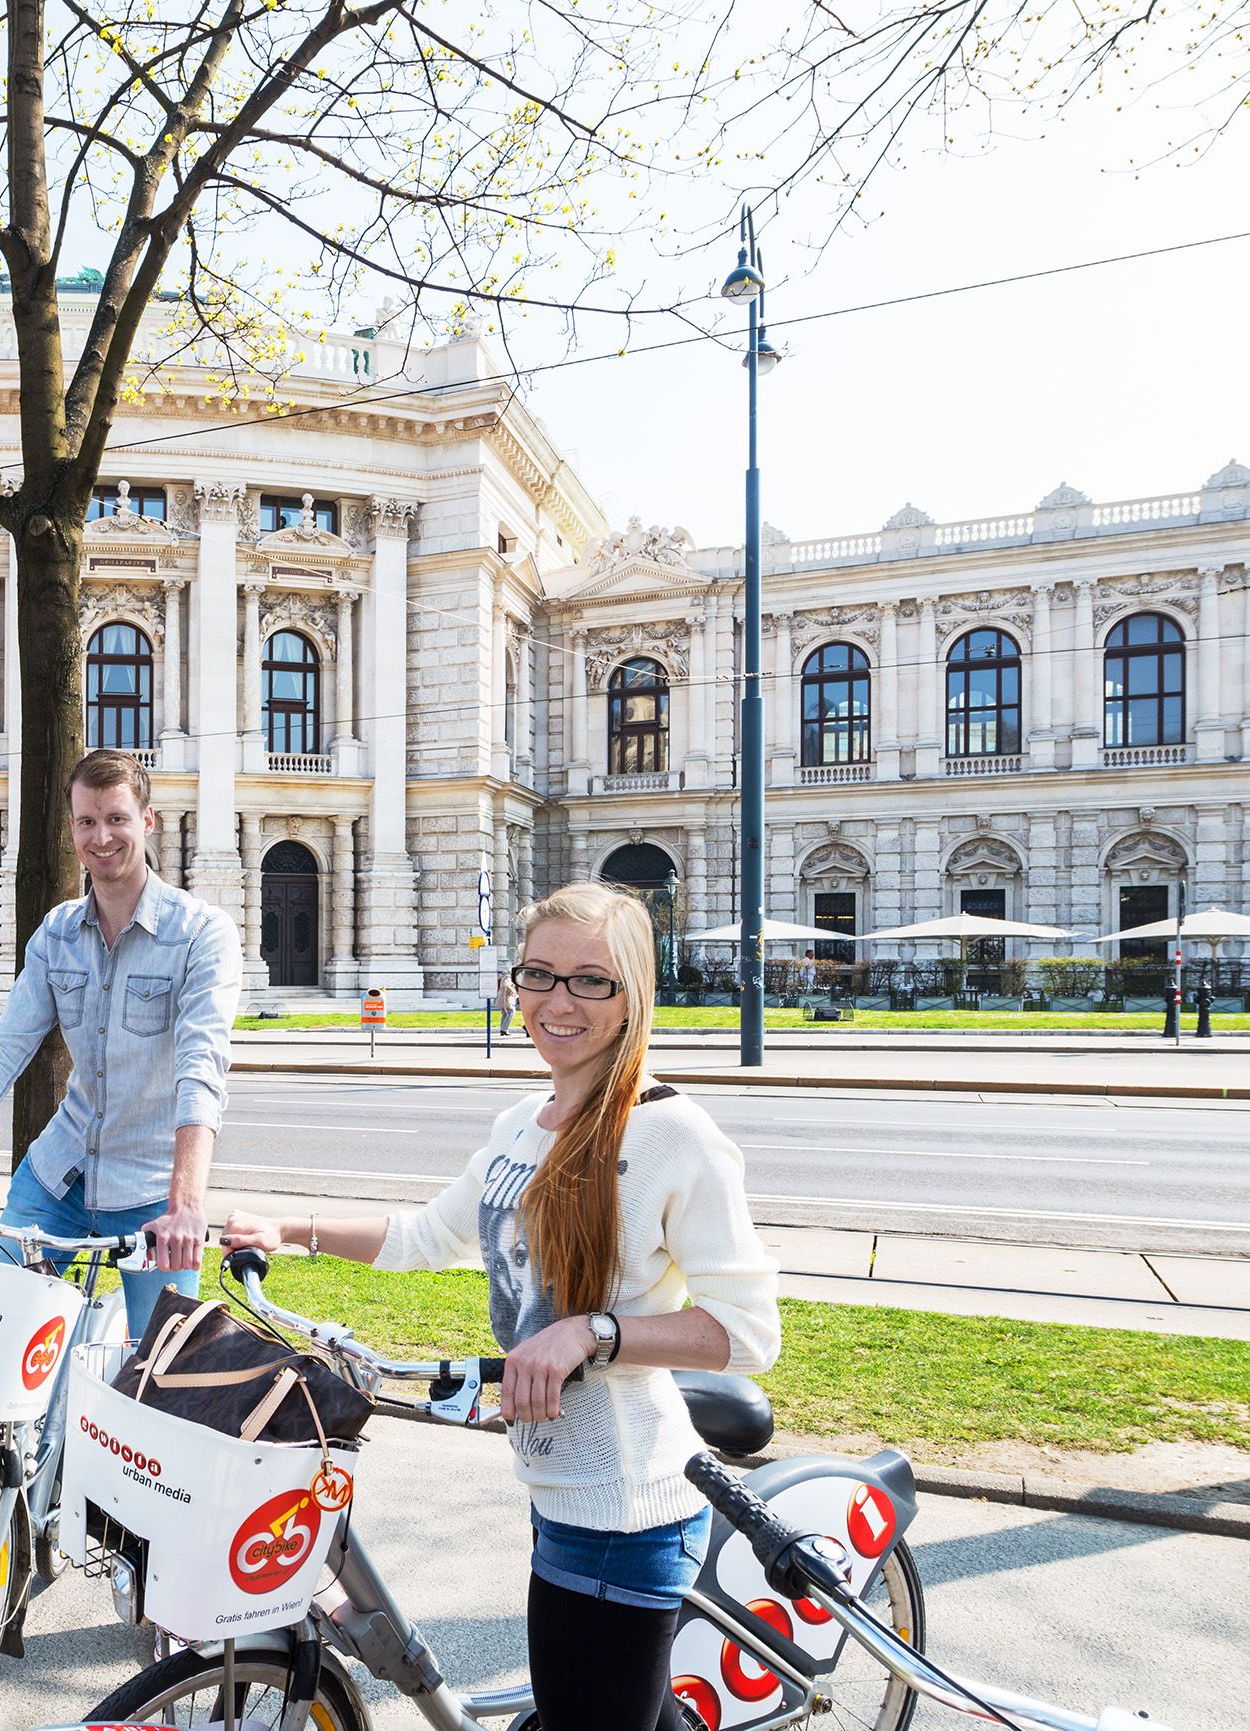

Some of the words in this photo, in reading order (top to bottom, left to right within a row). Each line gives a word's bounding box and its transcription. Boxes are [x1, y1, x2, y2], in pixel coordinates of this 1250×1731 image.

[122, 1464, 152, 1489] urban
[153, 1481, 192, 1504] media
[252, 1539, 298, 1558] citybike
[215, 1612, 242, 1625] Gratis
[244, 1608, 271, 1620] fahren
[271, 1604, 280, 1615] in
[281, 1598, 304, 1612] Wien!
